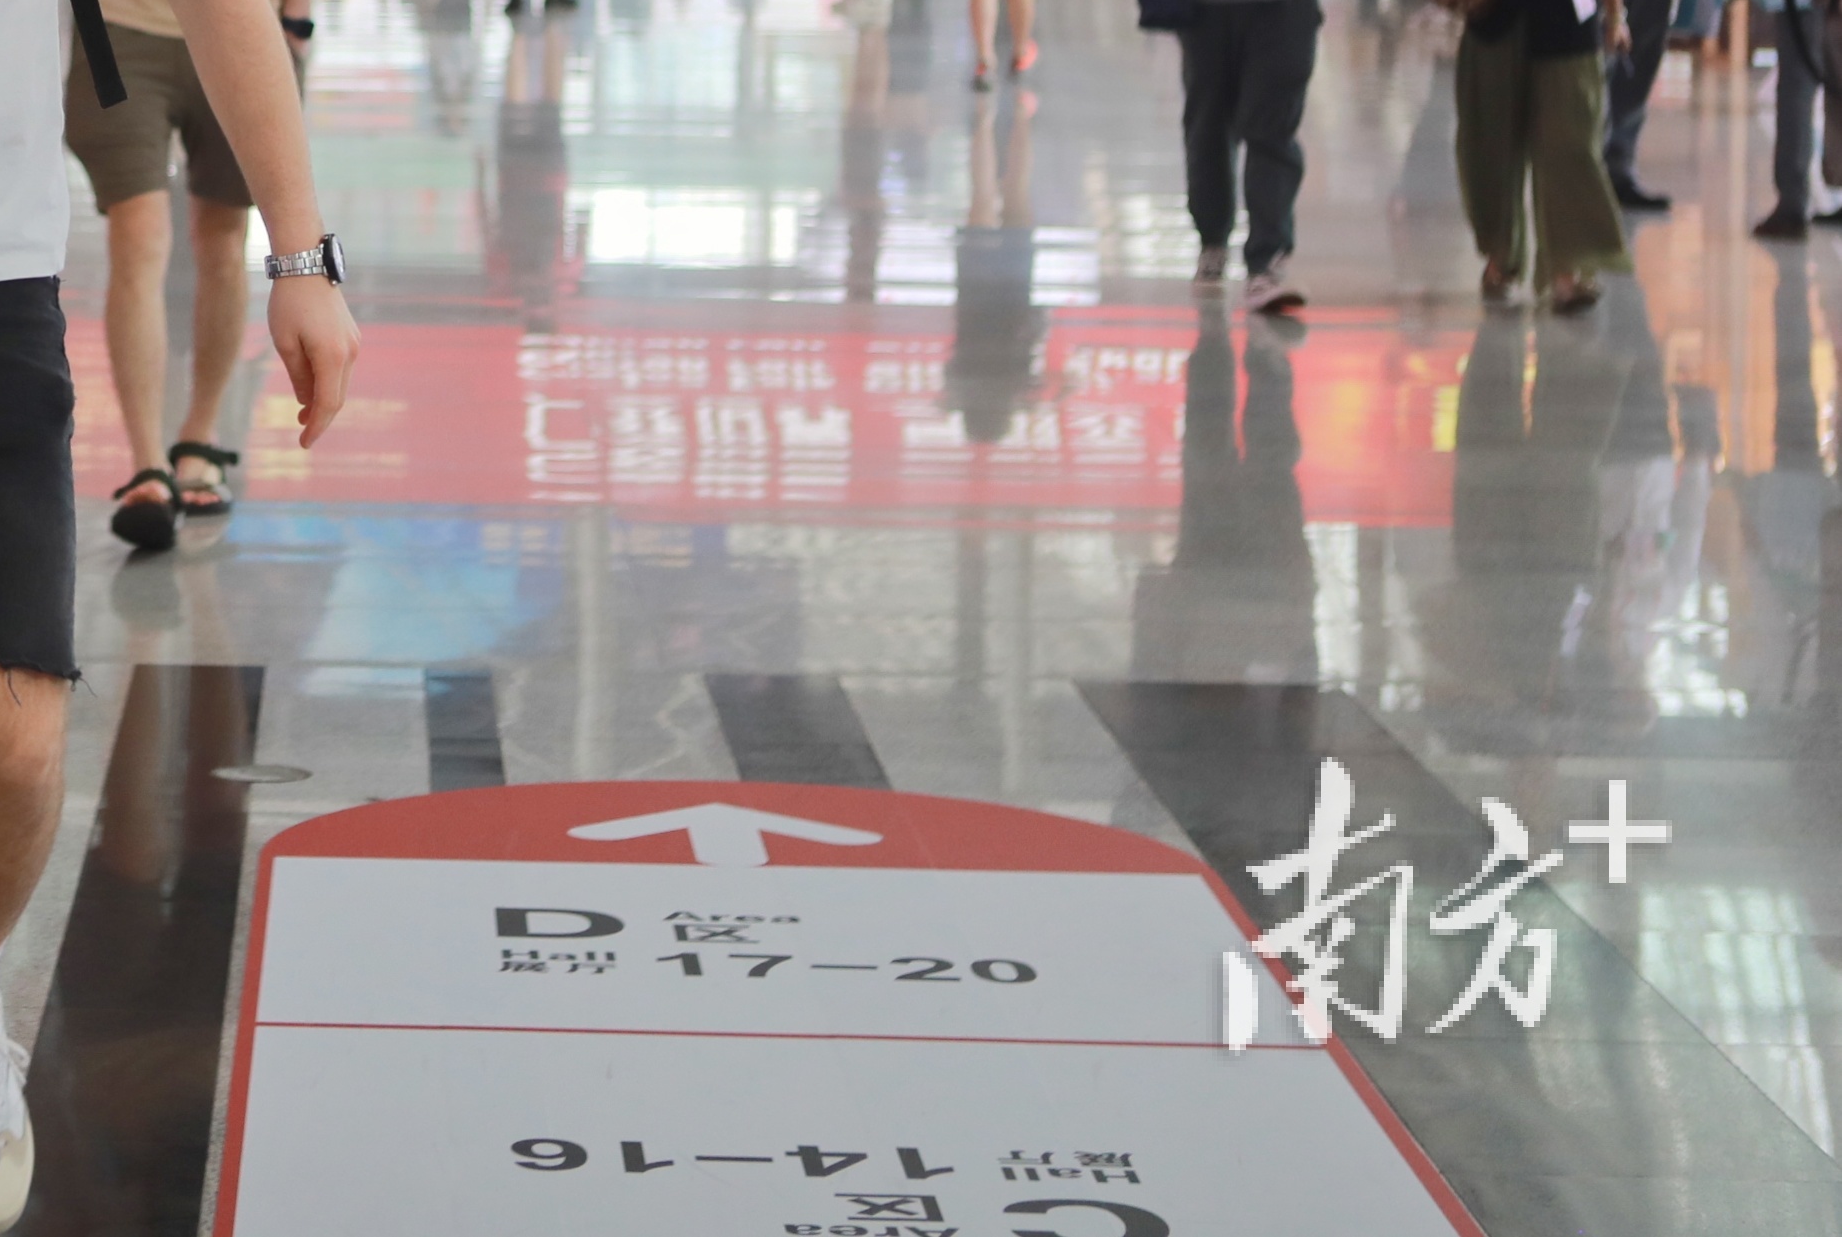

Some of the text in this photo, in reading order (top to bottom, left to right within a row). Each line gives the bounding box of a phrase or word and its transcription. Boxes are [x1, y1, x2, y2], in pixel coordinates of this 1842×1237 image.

[495, 907, 625, 937] D
[662, 910, 801, 923] Area
[673, 924, 761, 943] 区
[502, 949, 616, 961] Hall
[1001, 1167, 1141, 1184] Hall
[834, 1193, 944, 1222] 区
